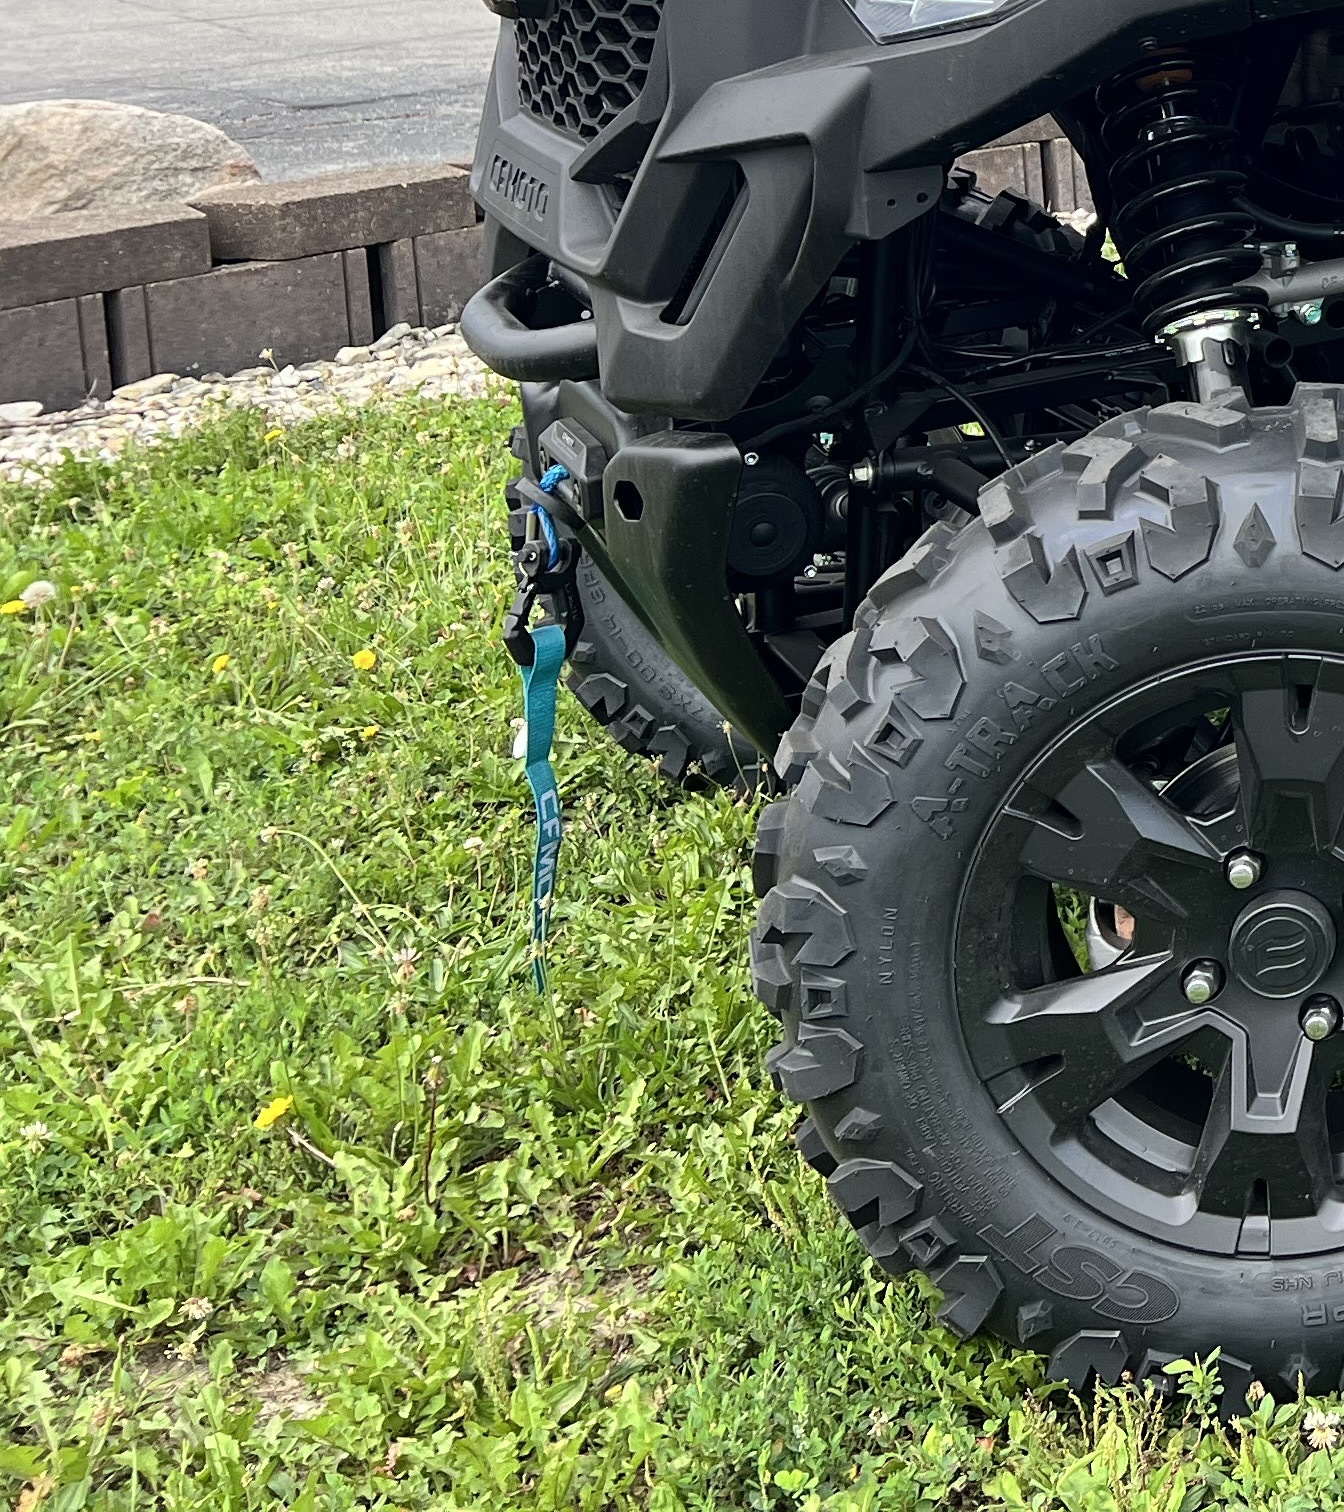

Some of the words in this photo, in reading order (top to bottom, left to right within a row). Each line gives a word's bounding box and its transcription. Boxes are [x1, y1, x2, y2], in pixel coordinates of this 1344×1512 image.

[489, 154, 549, 223] CFMOTO
[910, 631, 1120, 841] A-TRACK
[878, 904, 900, 987] NYLON
[976, 1212, 1181, 1325] CST
